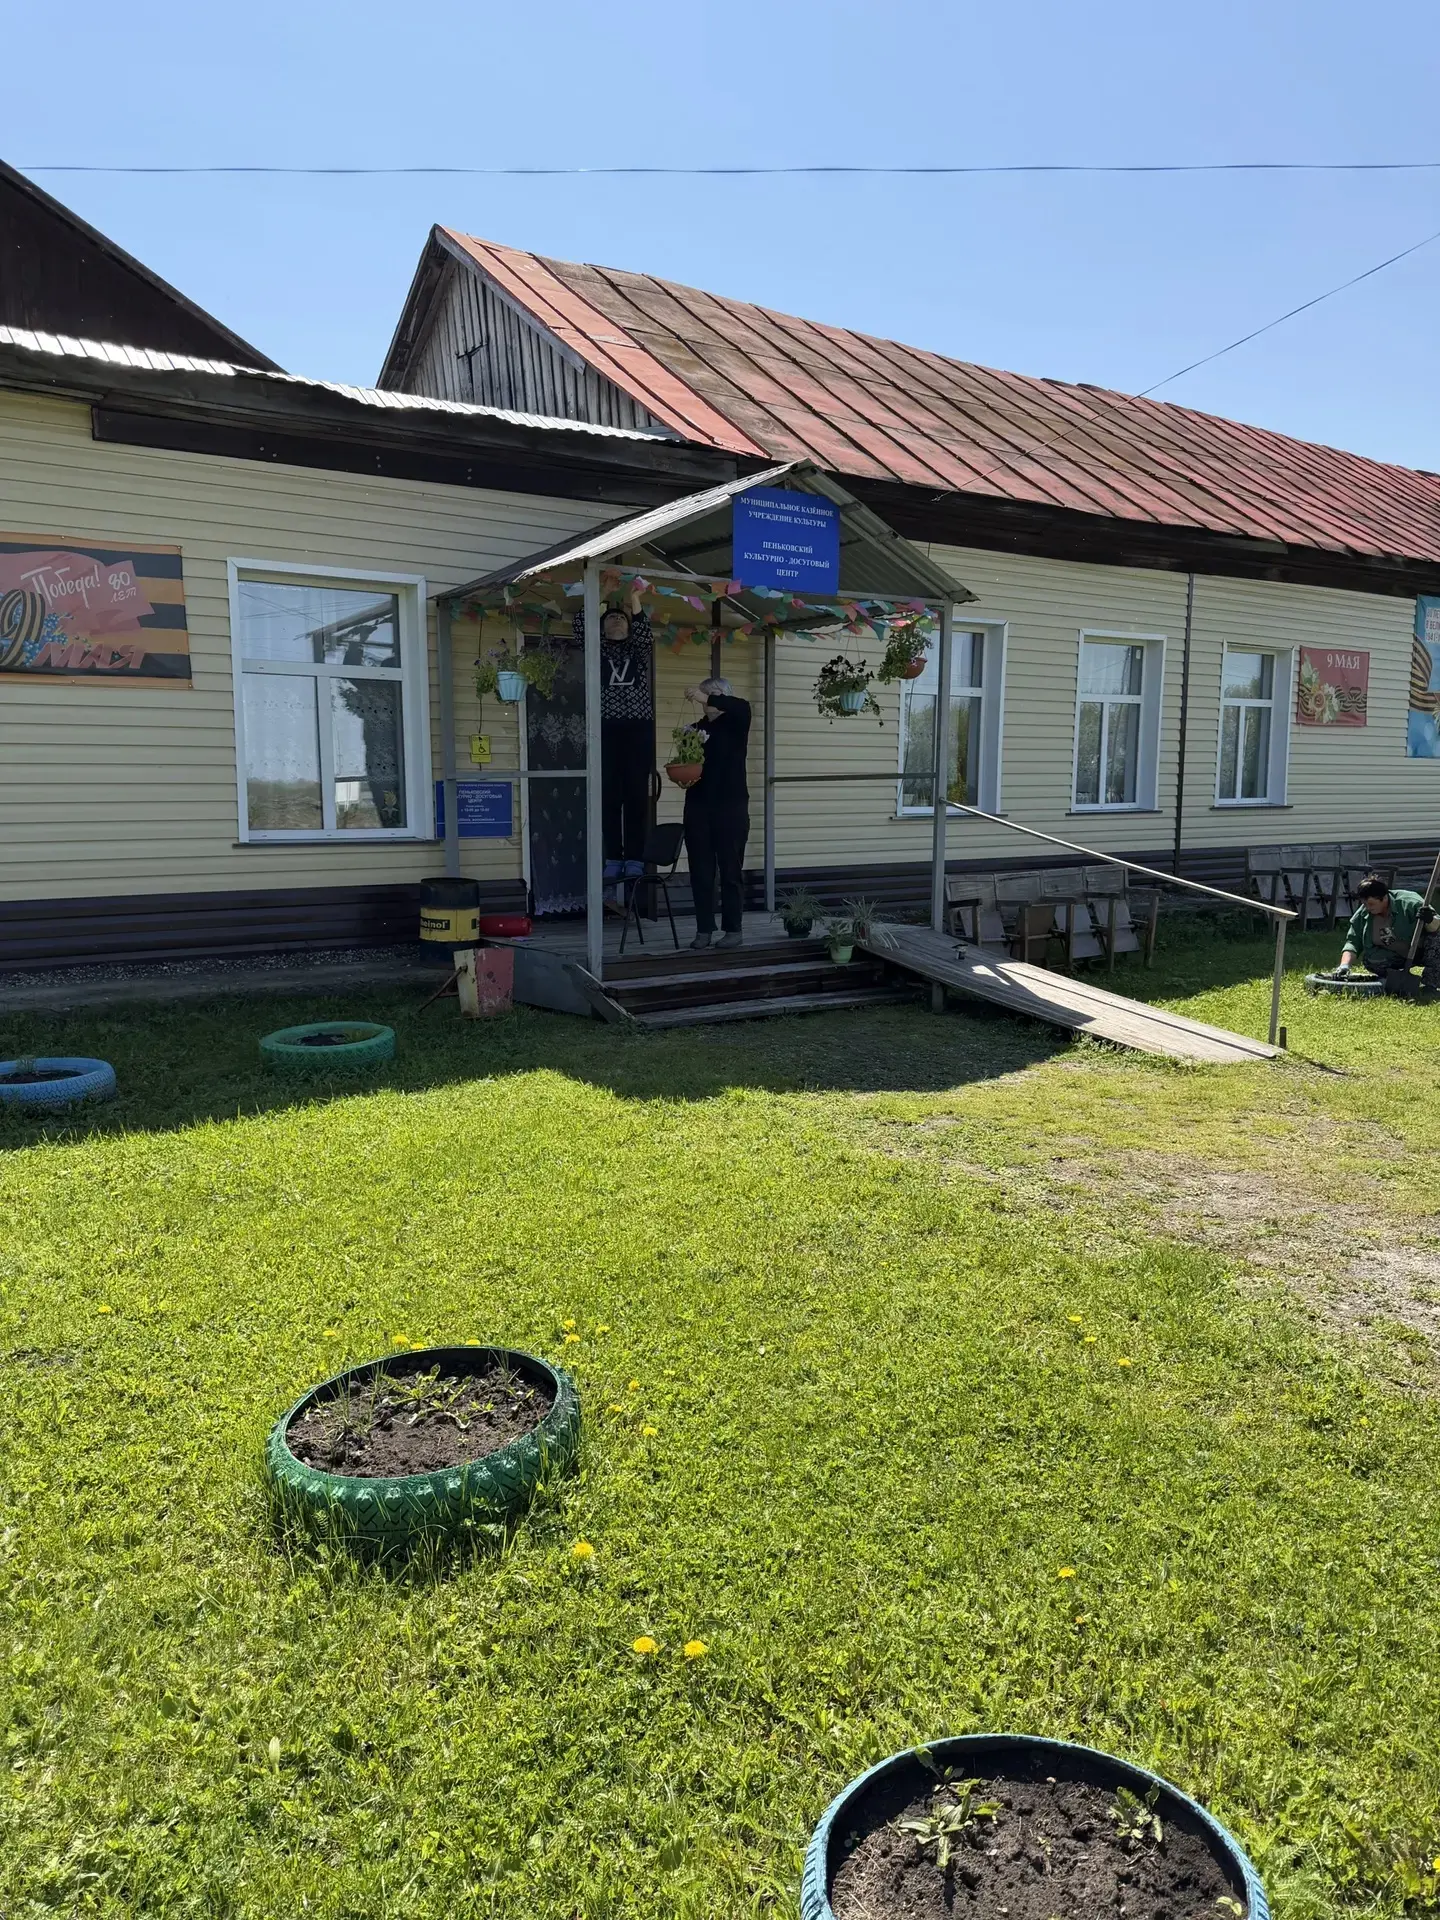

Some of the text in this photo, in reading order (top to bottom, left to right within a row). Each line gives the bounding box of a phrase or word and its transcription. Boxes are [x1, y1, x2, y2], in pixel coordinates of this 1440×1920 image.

[740, 497, 834, 517] МУНИЦИПАЛЬНОЕ КАЗЁННОЕ
[748, 510, 827, 528] УЧРЕЖДЕНИЕ КУЛЬТУРЫ
[762, 541, 813, 554] ПЕНЬКОВСКИЙ
[743, 552, 784, 563] КУЛЬТУРНО
[788, 557, 830, 569] ДОСУГОВЫЙ
[108, 571, 131, 590] 80
[776, 568, 799, 577] ЦЕНТР
[20, 564, 101, 609] Победа!
[1326, 654, 1360, 670] 9 МАЯ
